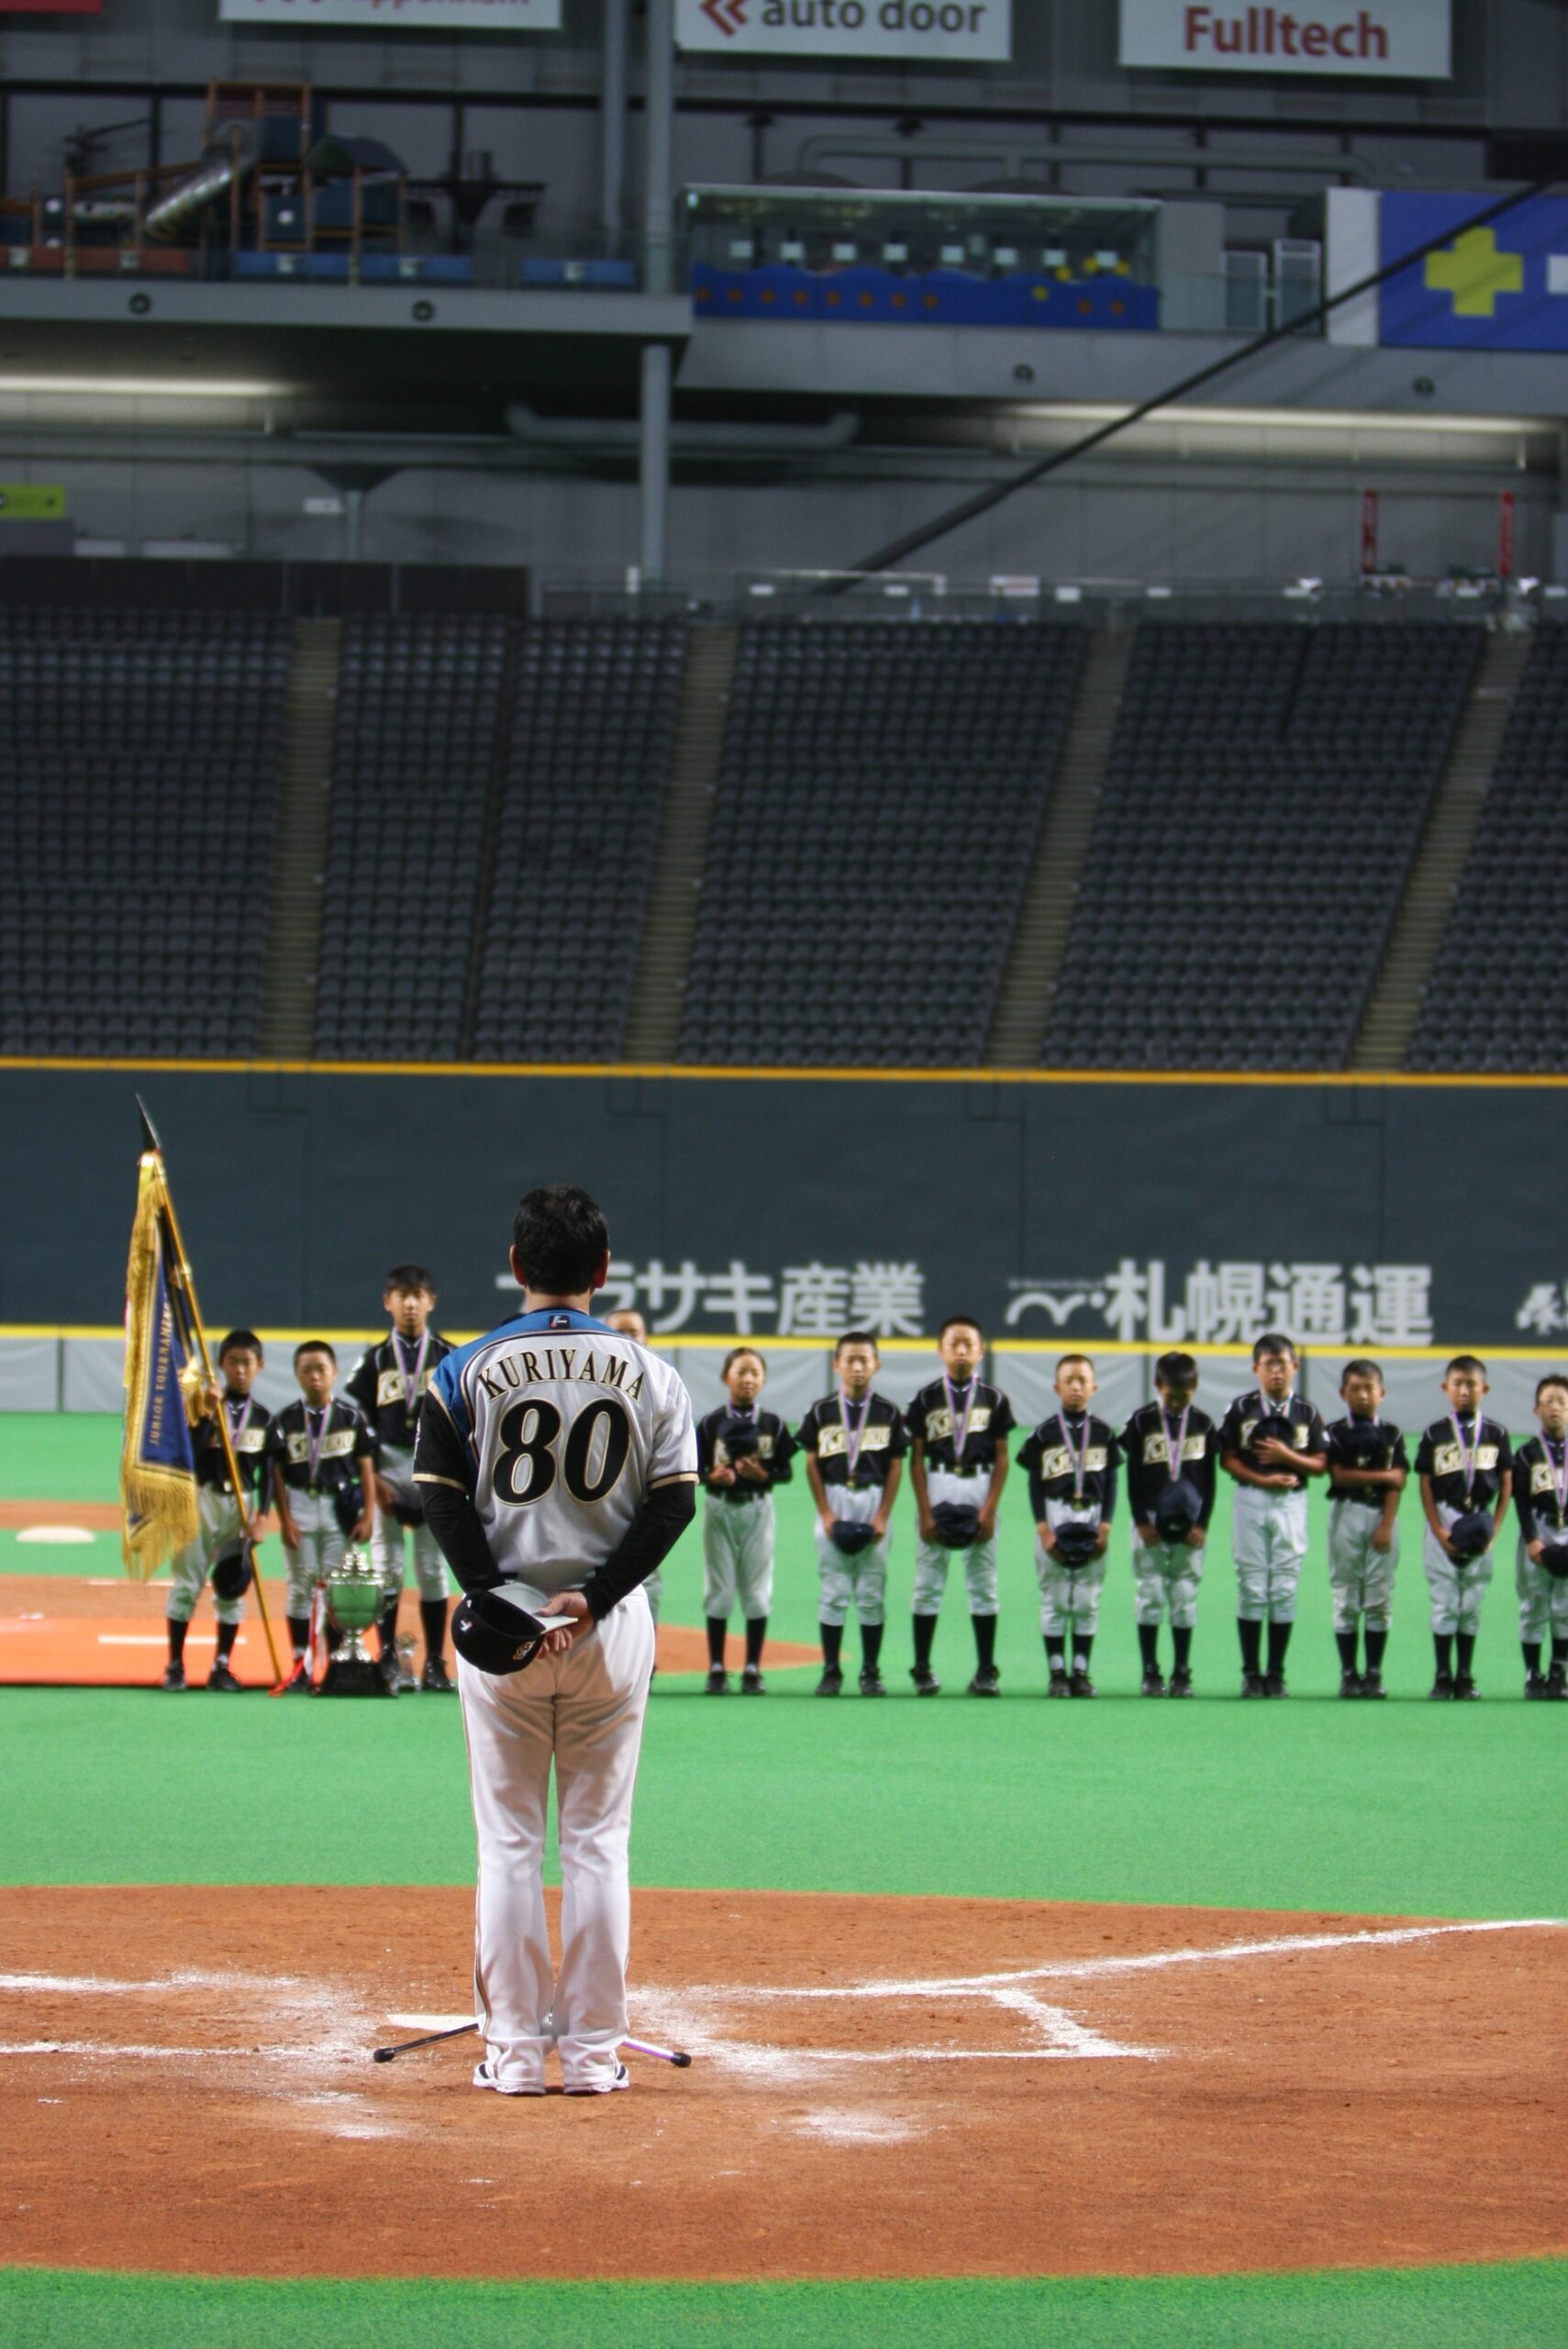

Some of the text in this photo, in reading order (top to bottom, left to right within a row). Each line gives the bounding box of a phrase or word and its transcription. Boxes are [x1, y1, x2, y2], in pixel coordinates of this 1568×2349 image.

[762, 0, 986, 33] auto door
[1184, 5, 1391, 59] Fulltech
[1105, 1258, 1433, 1346] 札幌通運
[476, 1347, 646, 1402] KURIYAMA
[150, 1397, 164, 1447] JUNIOR
[492, 1397, 632, 1508] 80
